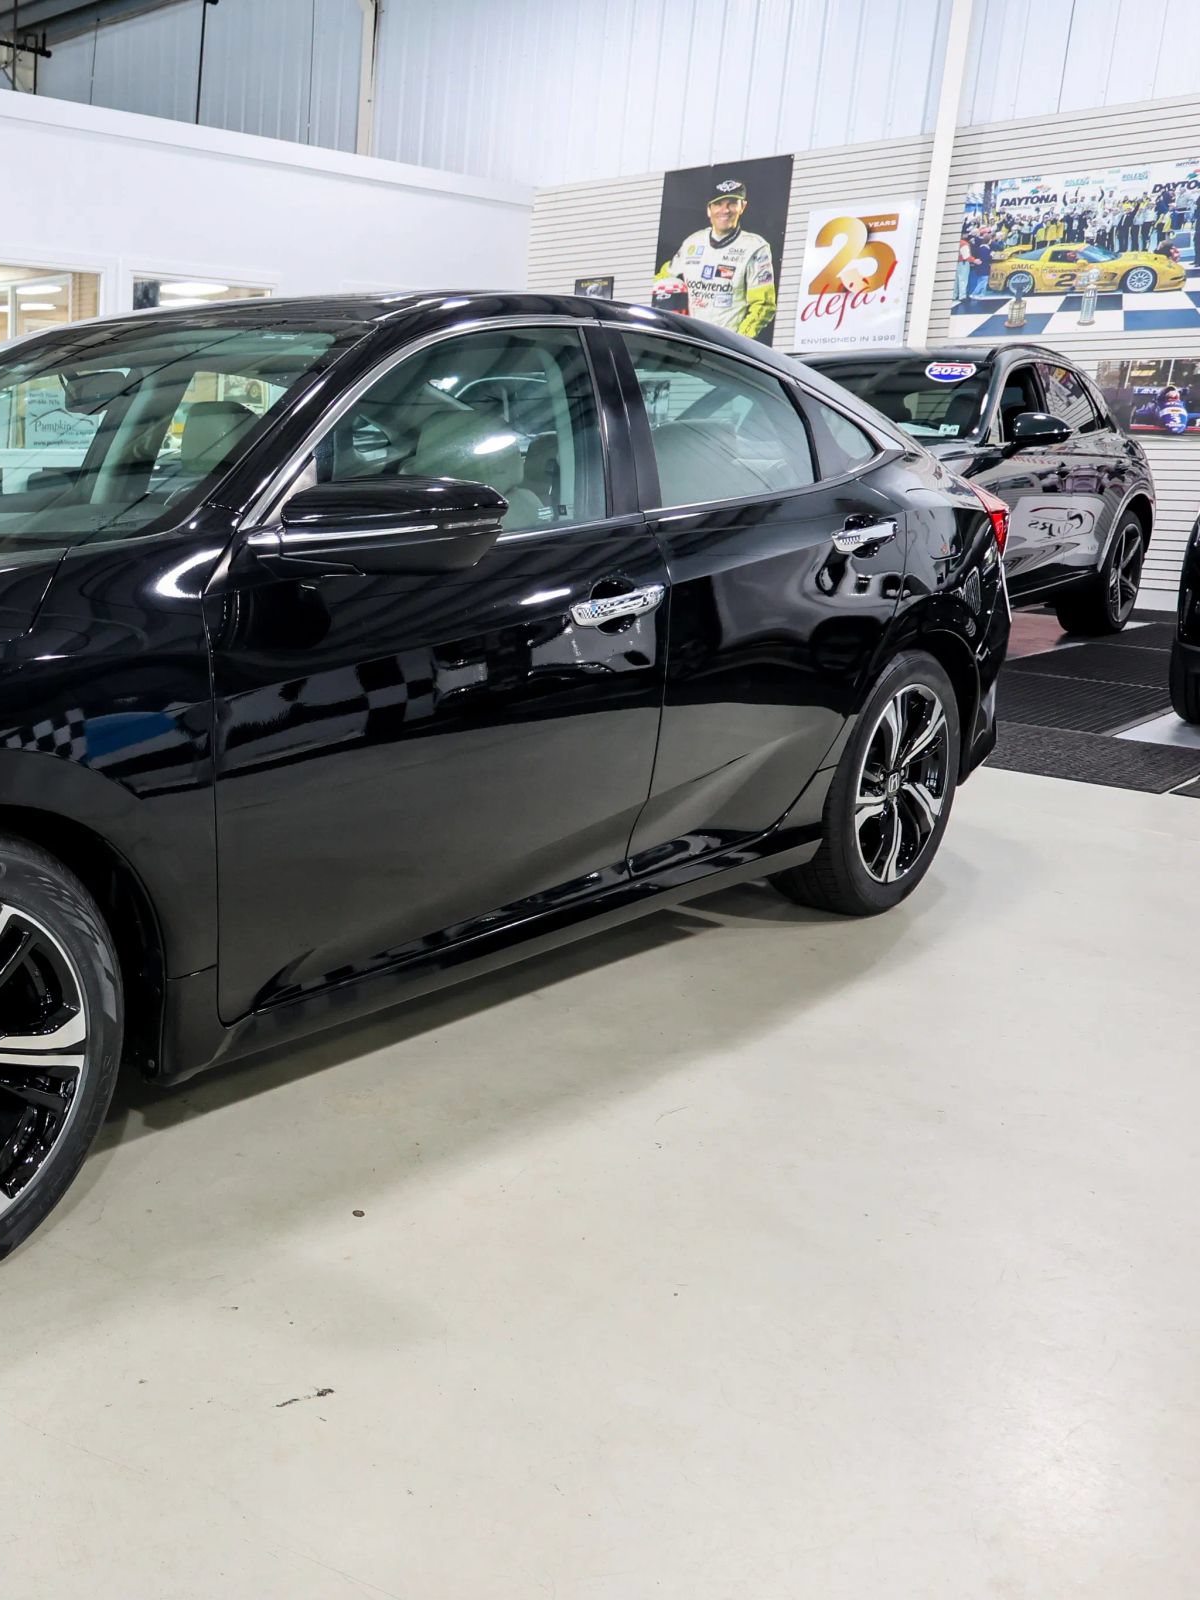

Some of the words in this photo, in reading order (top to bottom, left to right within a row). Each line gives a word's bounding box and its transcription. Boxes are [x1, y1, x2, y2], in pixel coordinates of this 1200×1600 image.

[1152, 180, 1200, 194] DAYTO
[1000, 194, 1057, 207] DAYTONA
[868, 219, 897, 228] YEARS
[687, 279, 733, 292] oodwrench
[1055, 273, 1077, 287] 2
[801, 336, 857, 344] ENVISIONED
